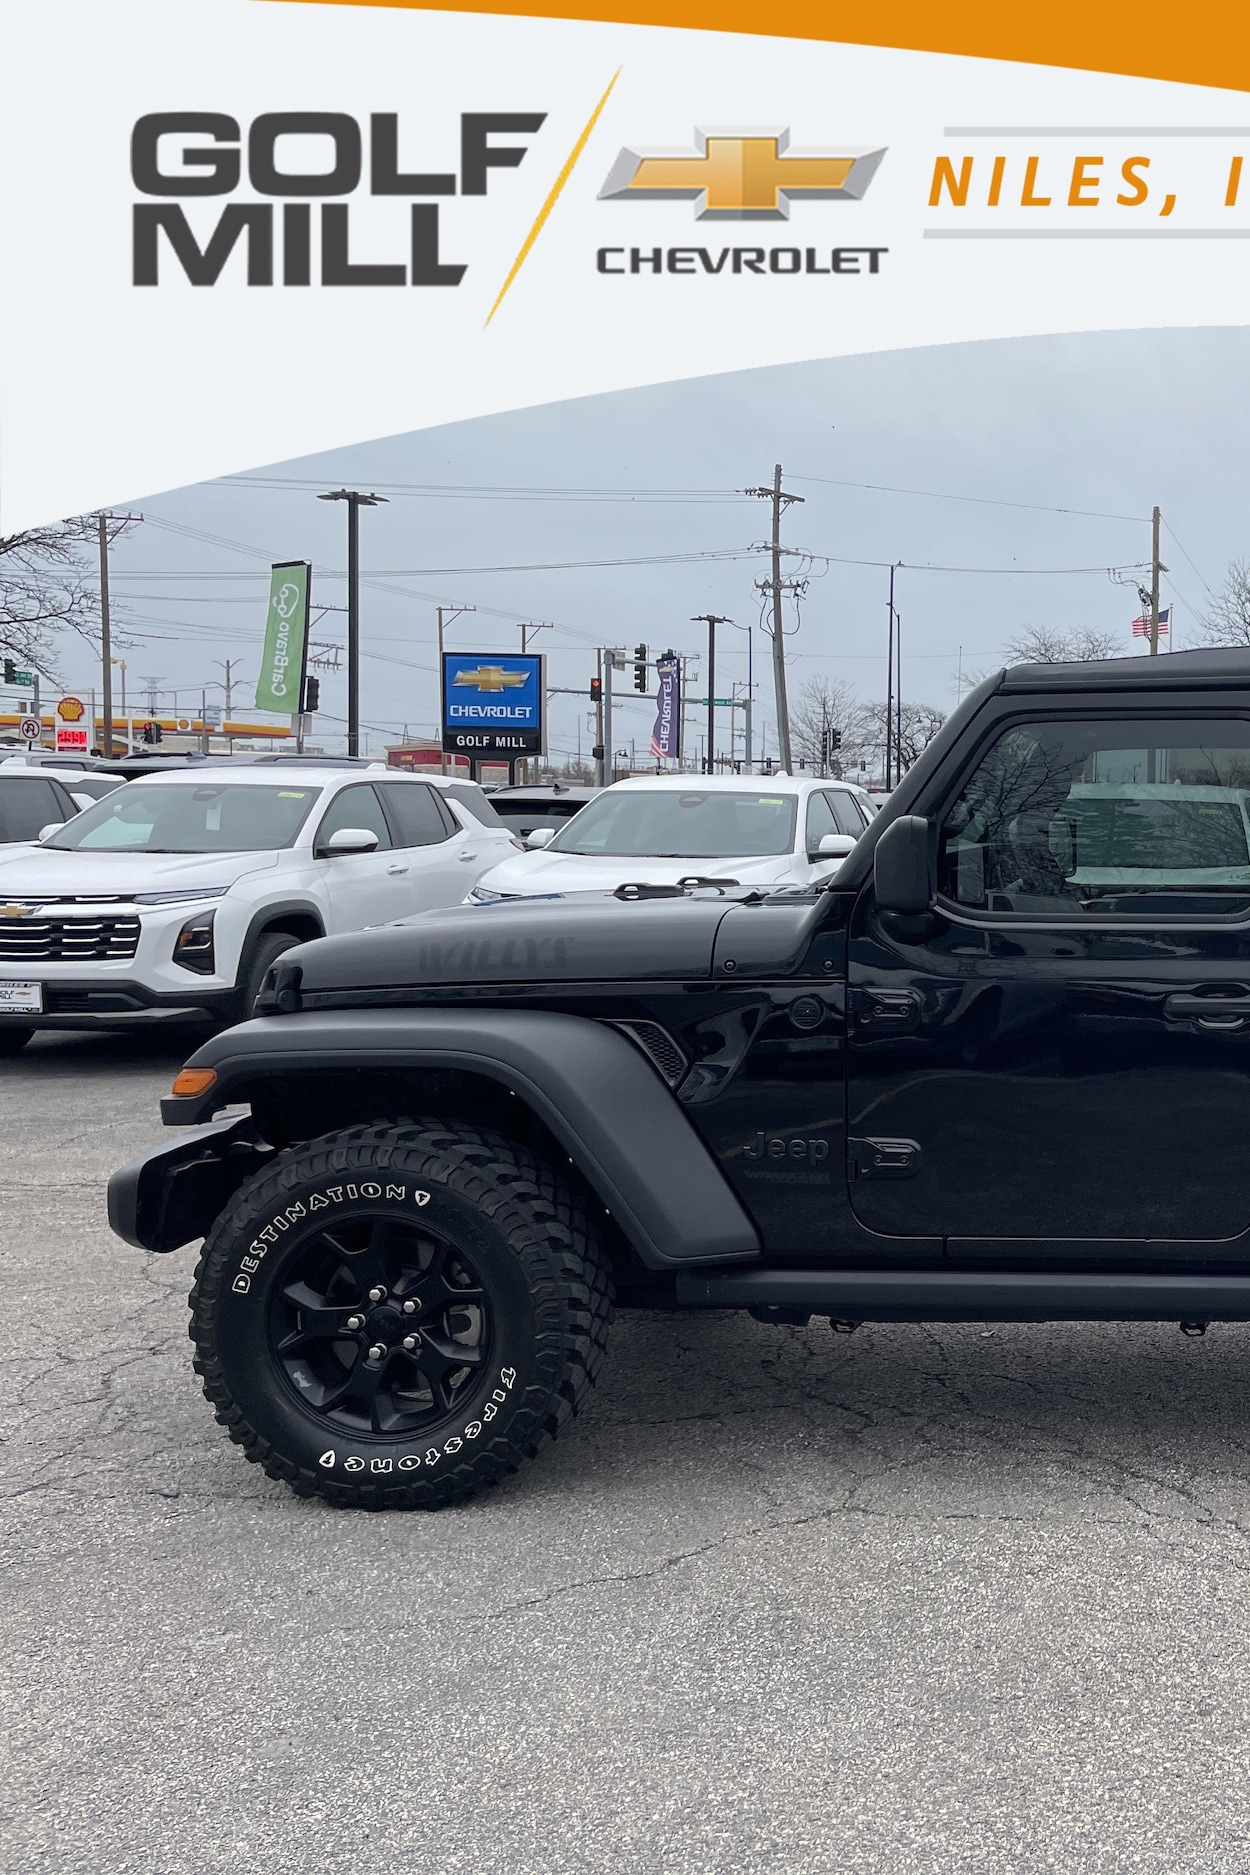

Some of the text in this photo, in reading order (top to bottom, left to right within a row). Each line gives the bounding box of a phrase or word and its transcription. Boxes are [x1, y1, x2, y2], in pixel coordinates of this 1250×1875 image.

[449, 705, 533, 719] CHEVROLET
[456, 735, 527, 748] GOLF MILL
[742, 1131, 830, 1167] Jeep
[231, 1182, 406, 1297] DESTINATION
